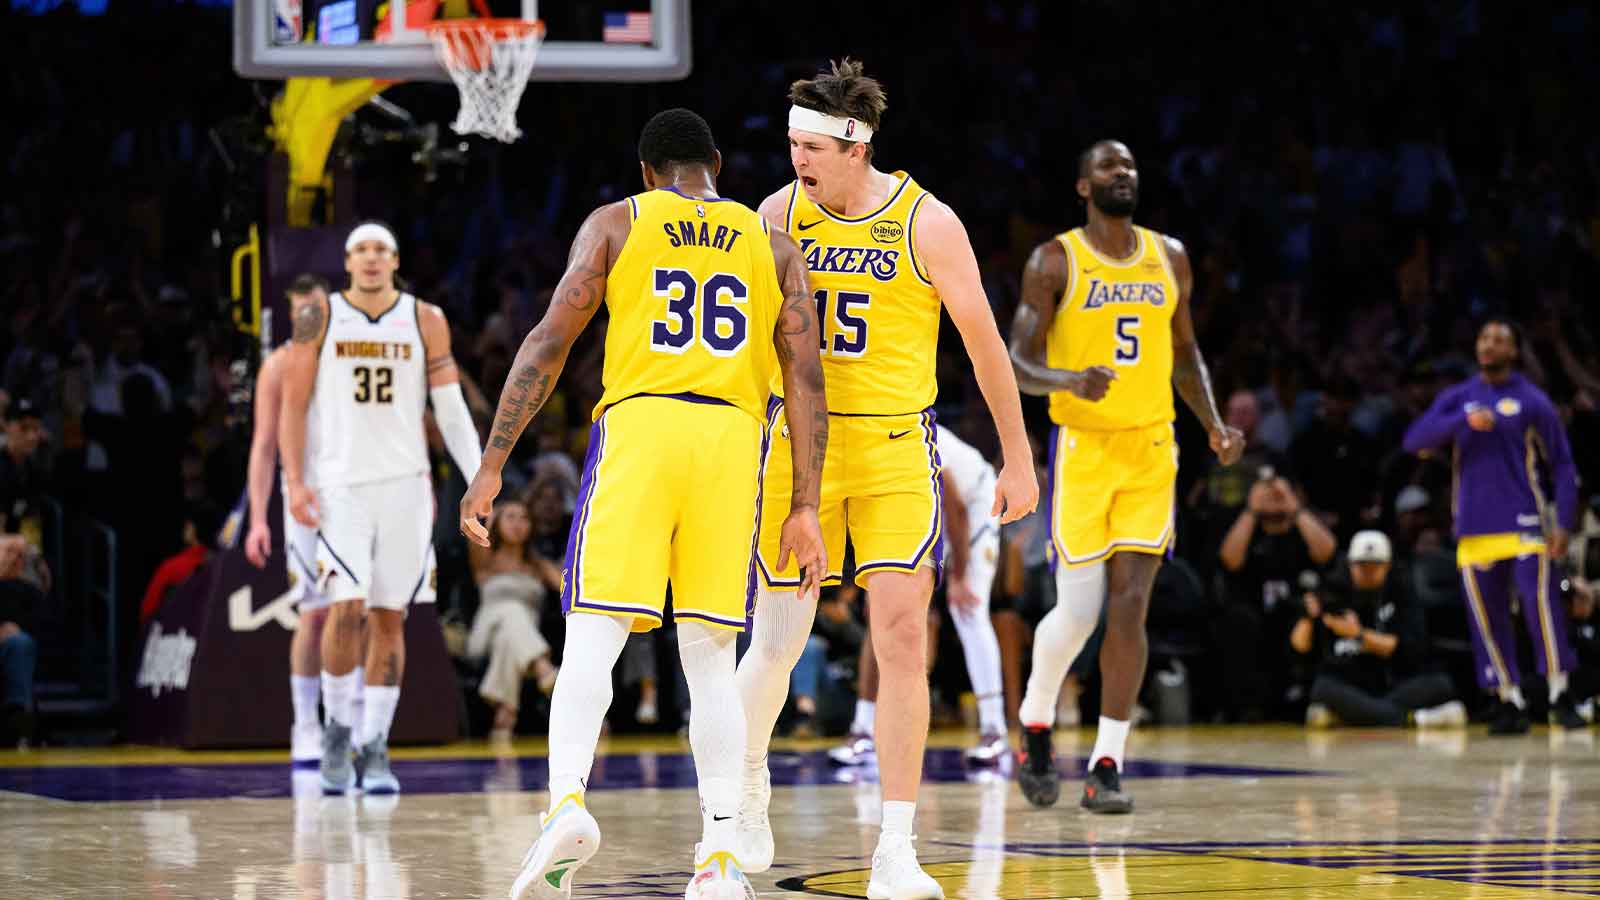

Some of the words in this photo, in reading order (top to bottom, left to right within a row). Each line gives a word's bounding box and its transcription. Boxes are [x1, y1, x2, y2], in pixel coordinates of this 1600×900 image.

[663, 219, 742, 253] SMART
[873, 226, 901, 237] bibigo
[800, 238, 900, 281] AKERS
[650, 267, 749, 357] 36
[1082, 278, 1166, 309] LAKERS
[813, 288, 871, 357] 15
[1113, 314, 1142, 365] 5
[335, 341, 412, 361] NUGGETS
[352, 365, 394, 404] 32
